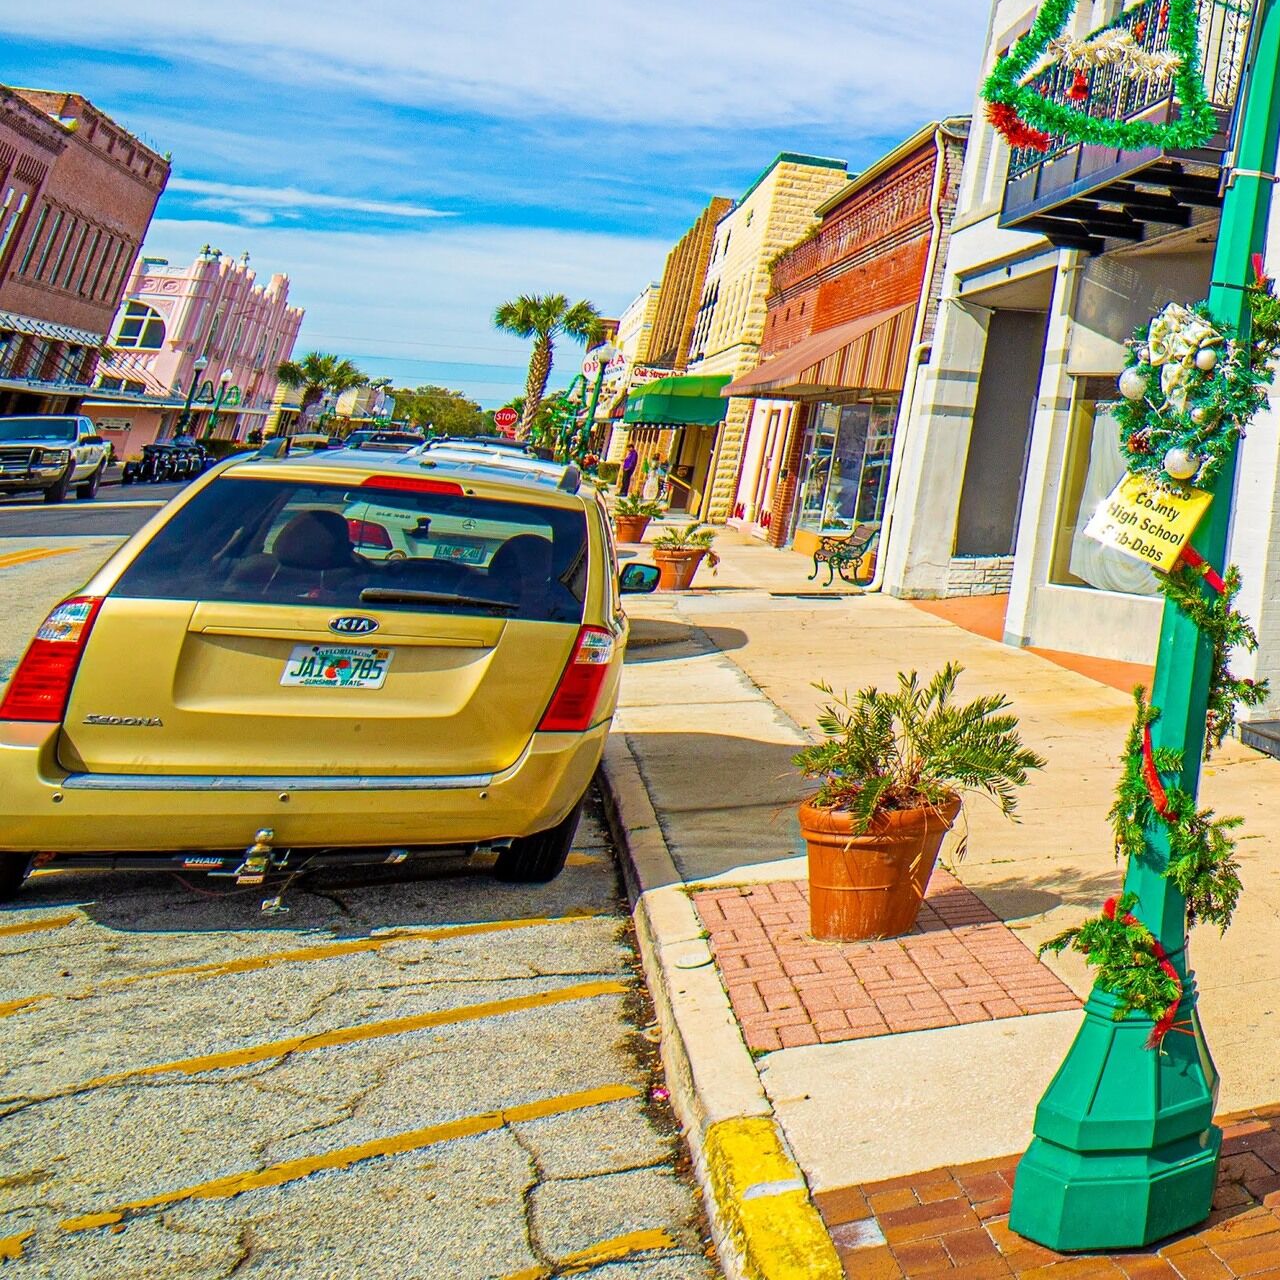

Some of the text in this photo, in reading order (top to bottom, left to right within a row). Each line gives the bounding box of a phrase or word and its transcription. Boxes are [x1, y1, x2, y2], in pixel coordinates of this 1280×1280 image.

[584, 354, 625, 373] OPRA
[634, 368, 648, 377] Oak
[496, 413, 517, 421] STOP
[1135, 491, 1181, 523] County
[1106, 501, 1185, 546] High School
[336, 618, 370, 631] KIA
[184, 856, 225, 865] U-HAUL
